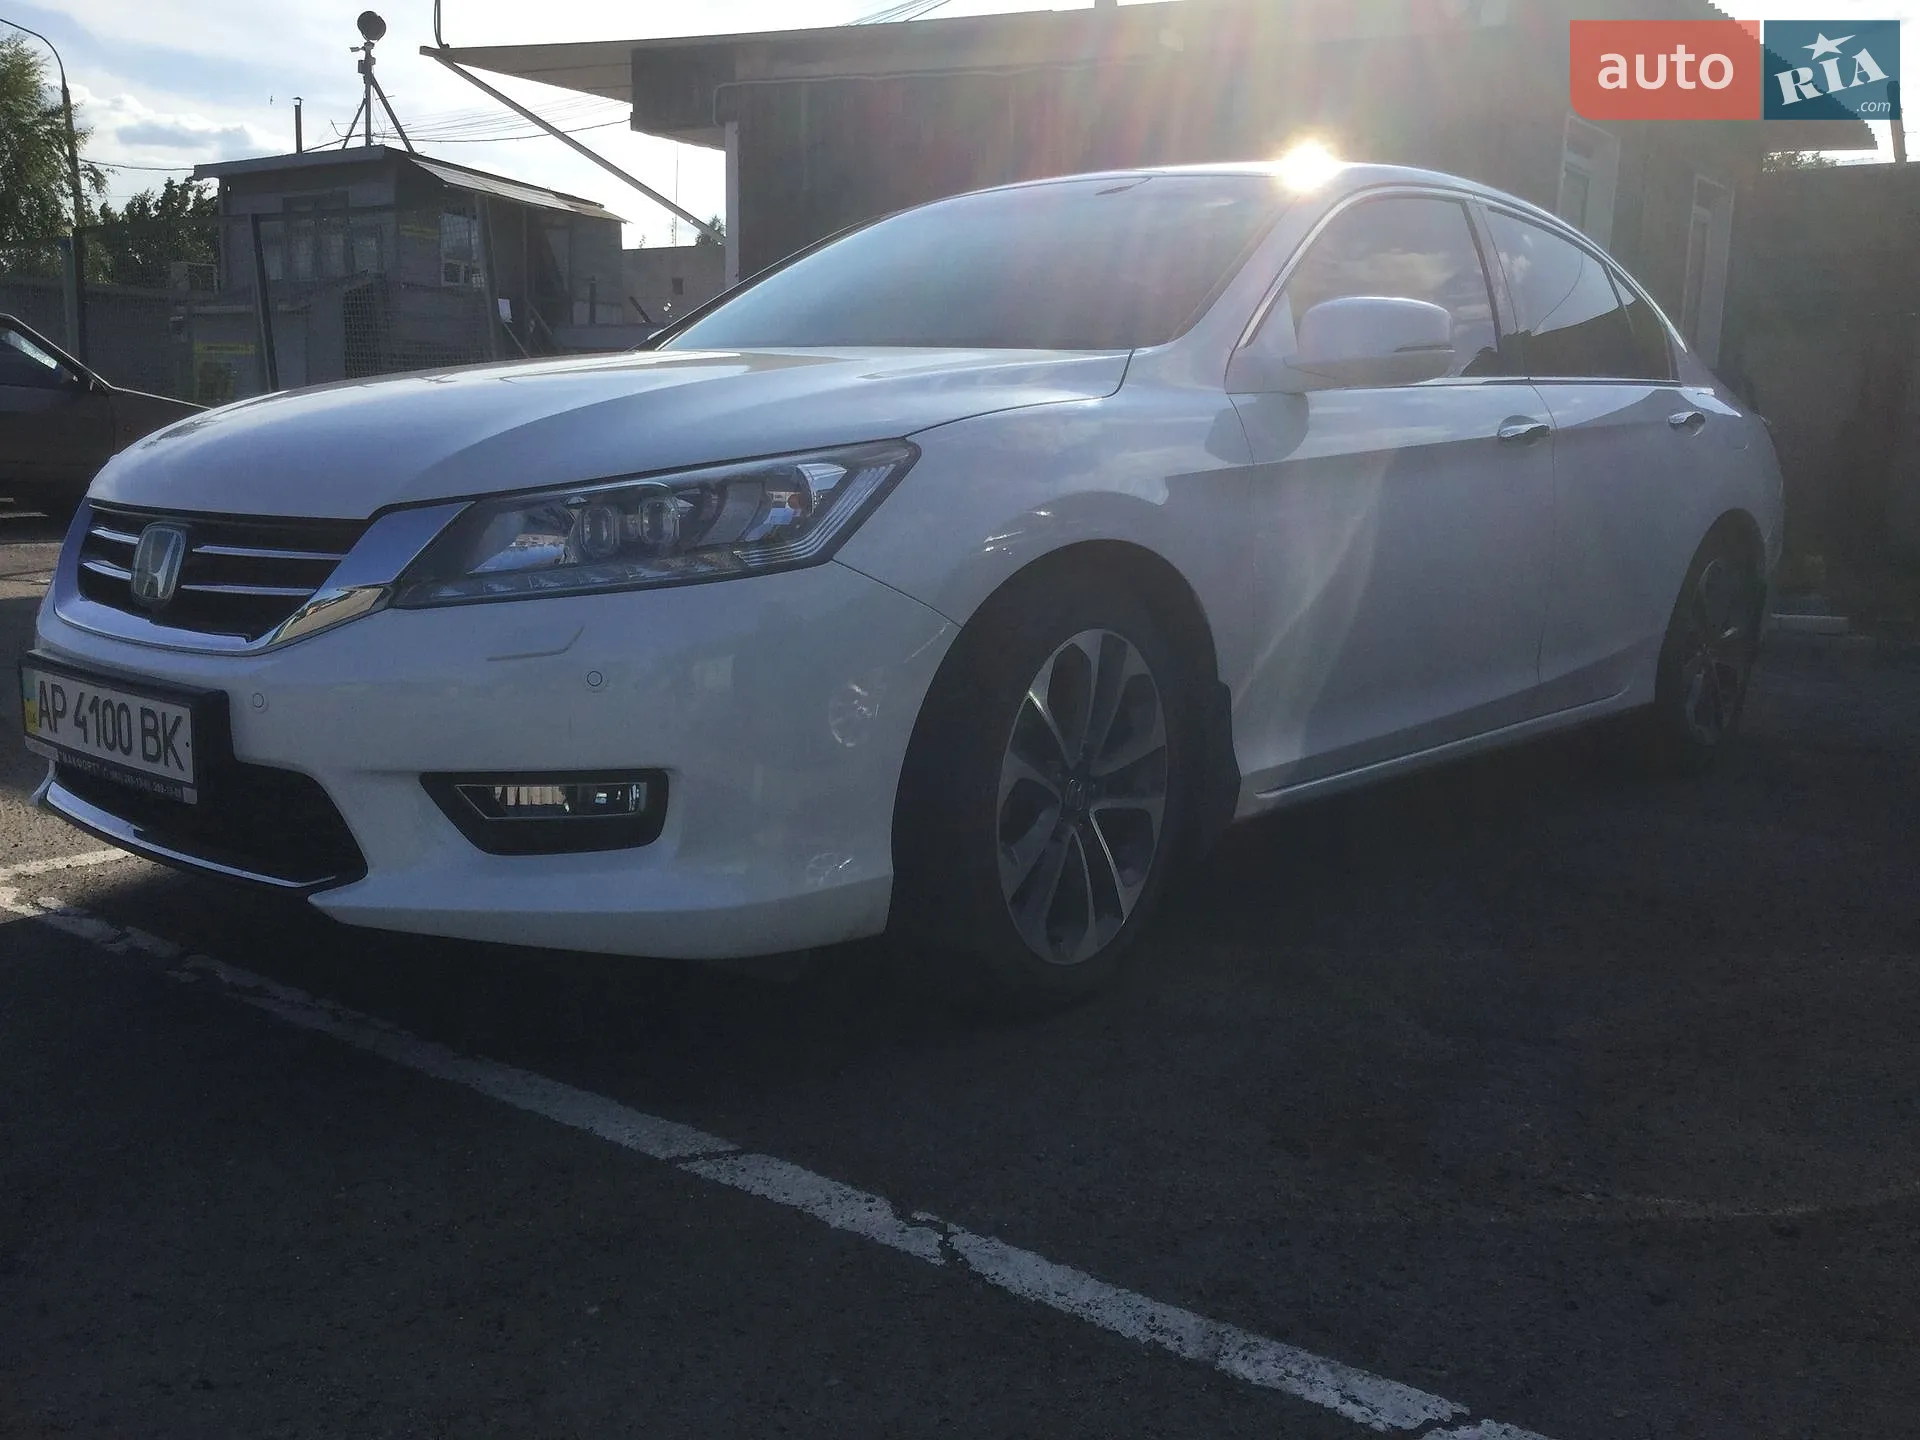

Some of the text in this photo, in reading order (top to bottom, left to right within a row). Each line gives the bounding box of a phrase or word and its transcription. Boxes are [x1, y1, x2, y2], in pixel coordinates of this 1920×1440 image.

[38, 680, 186, 771] AP 4100 BK
